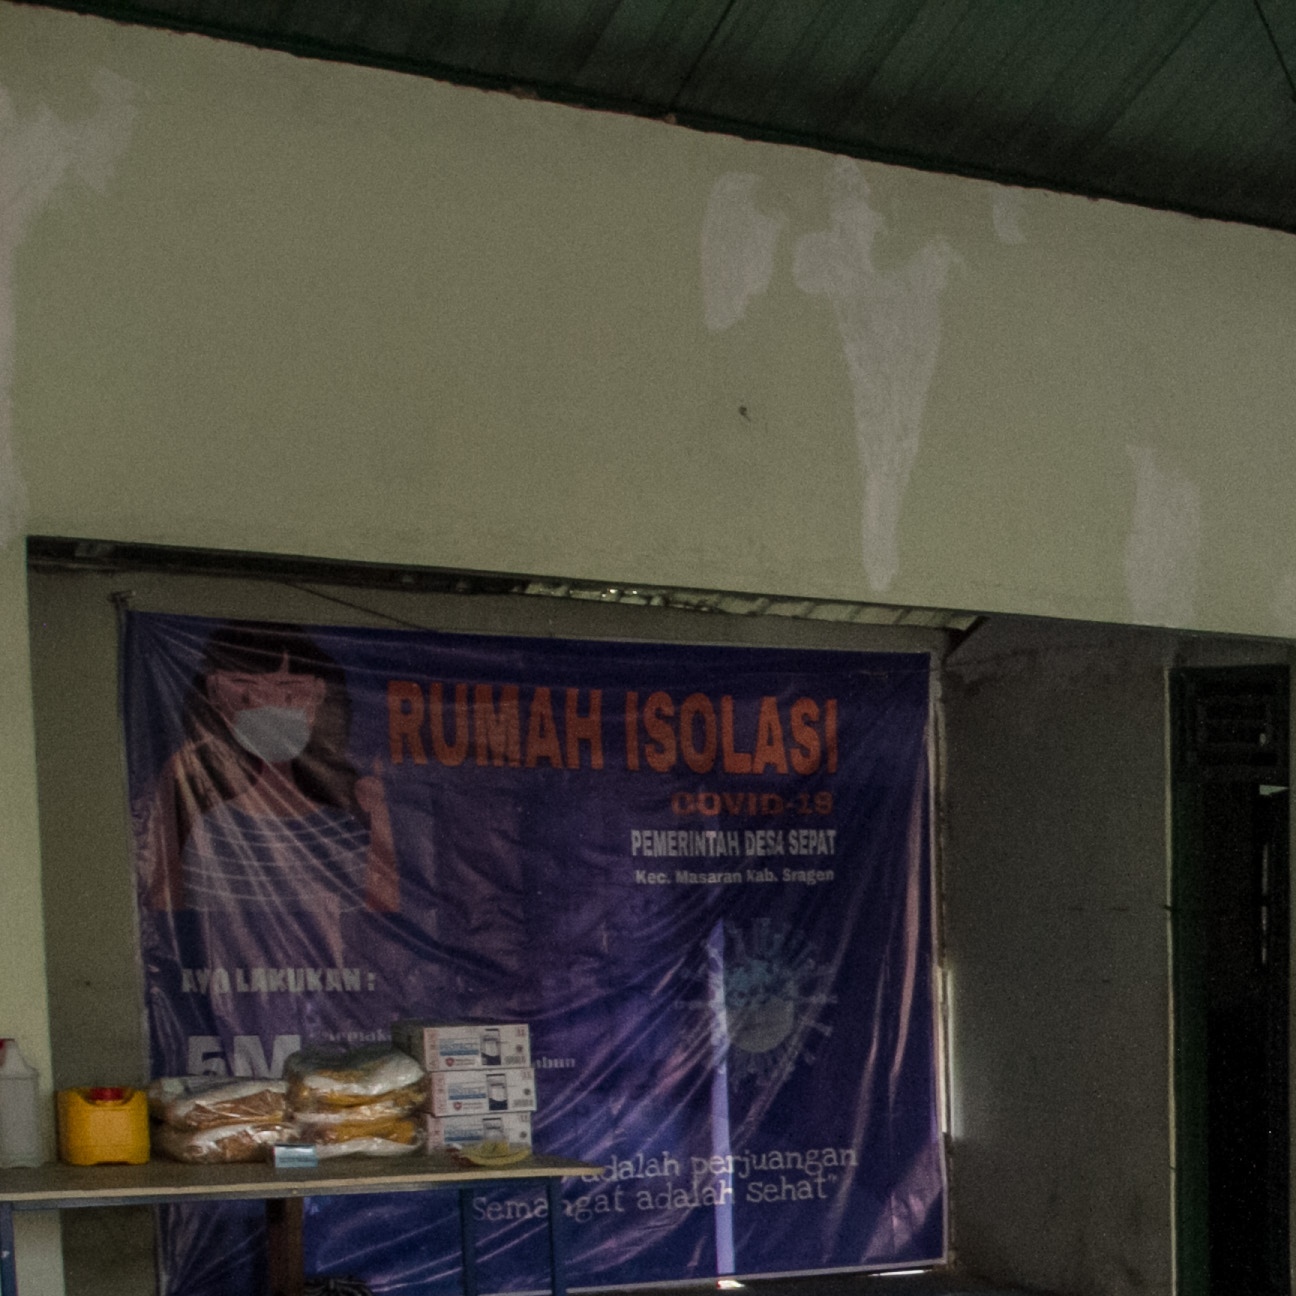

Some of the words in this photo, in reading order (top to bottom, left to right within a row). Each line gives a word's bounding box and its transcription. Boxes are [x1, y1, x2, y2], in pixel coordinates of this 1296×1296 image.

[387, 680, 604, 770] RUMAH
[625, 690, 839, 775] ISOLASI
[671, 791, 834, 816] COVID-19
[631, 829, 740, 857] PEMERINTAH
[744, 829, 784, 857] DESA
[788, 828, 837, 856] SEPAT
[635, 869, 671, 885] Kec.
[675, 869, 743, 884] Masaran
[782, 867, 835, 886] Sragen
[236, 967, 361, 993] LAKUKAN
[691, 1146, 859, 1184] perjuangan
[636, 1179, 733, 1211] adalah
